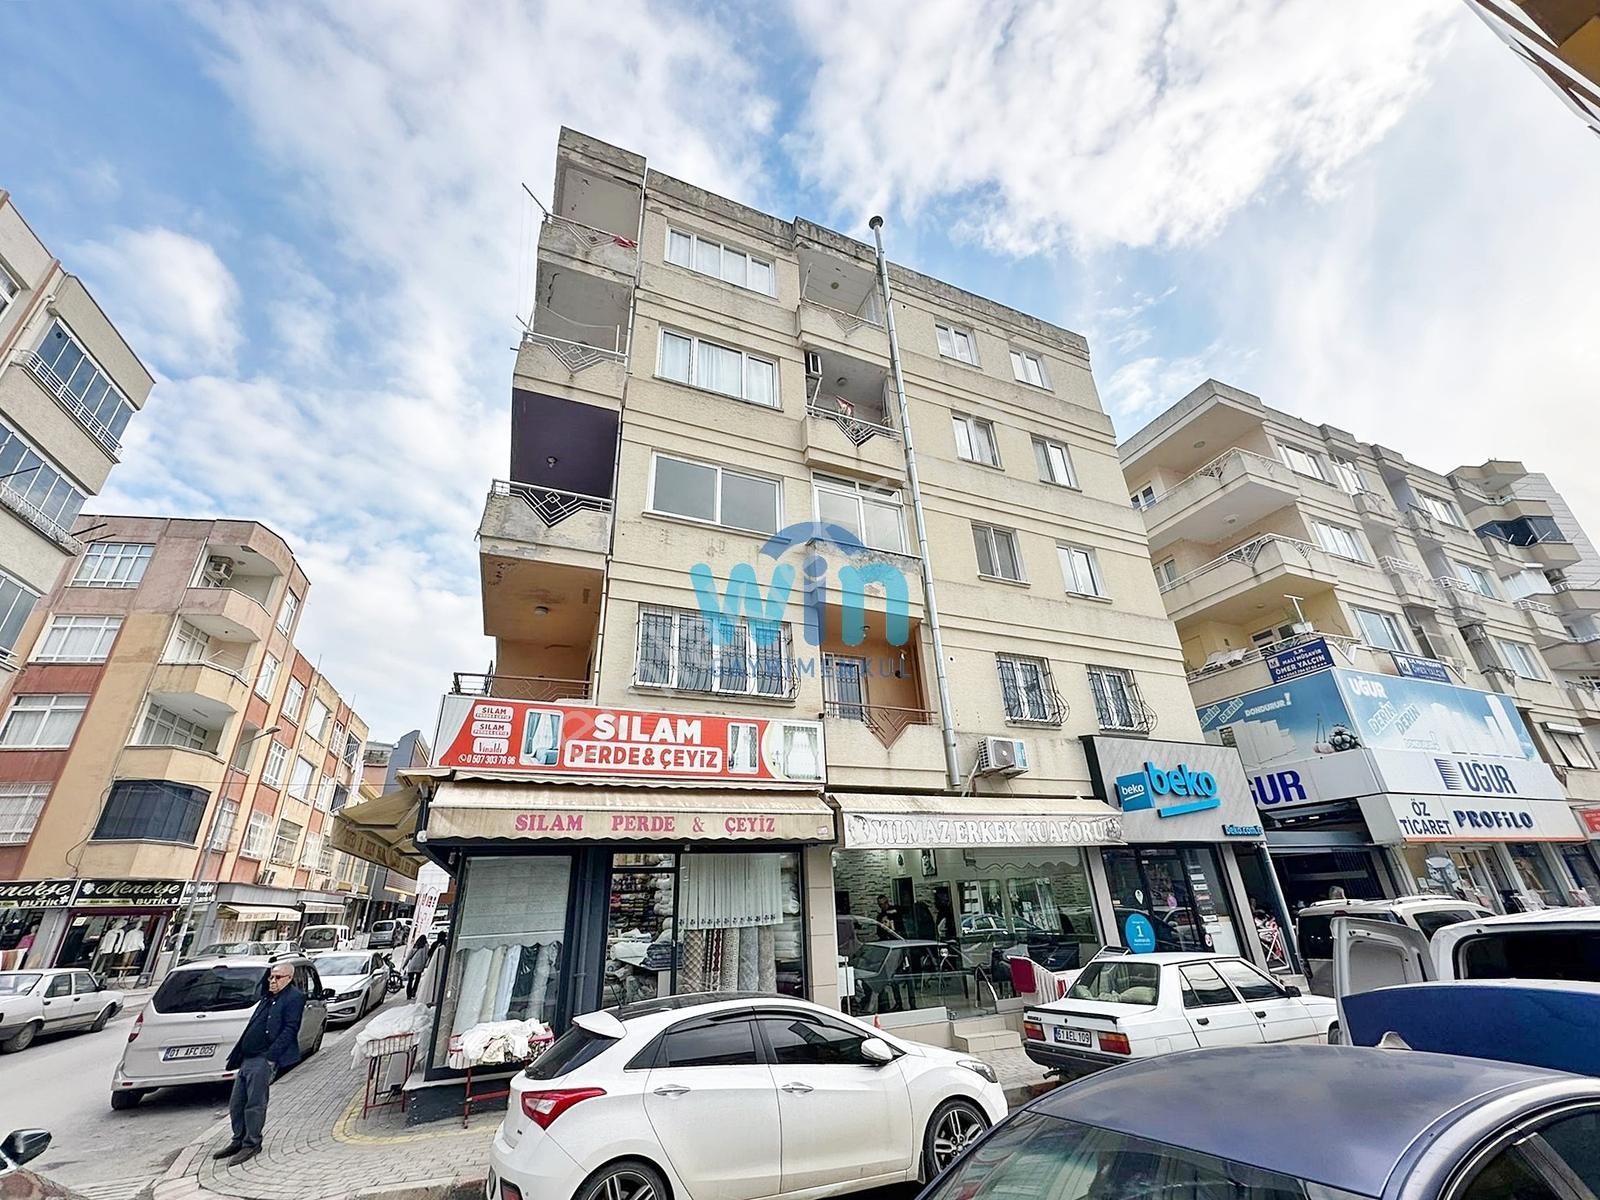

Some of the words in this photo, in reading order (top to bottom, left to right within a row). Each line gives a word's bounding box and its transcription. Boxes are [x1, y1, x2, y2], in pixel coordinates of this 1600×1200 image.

[1347, 676, 1388, 699] UĞUR
[1218, 697, 1244, 723] DERİN
[1368, 701, 1398, 735] DERİN
[1394, 704, 1422, 736] DERİN
[592, 713, 702, 745] SILAM
[1144, 760, 1217, 797] beko
[1458, 760, 1517, 794] UĞUR
[1121, 784, 1145, 796] beko
[1411, 798, 1431, 816] ÖZ
[515, 815, 583, 832] SILAM
[611, 815, 676, 832] PERDE
[692, 816, 705, 832] &
[725, 816, 775, 836] ÇEYİZ
[871, 818, 950, 844] YILMAZ
[952, 820, 1022, 844] ERKEK
[1399, 815, 1453, 835] TİCARET
[95, 881, 180, 898] Menekşe
[1135, 925, 1144, 937] 1
